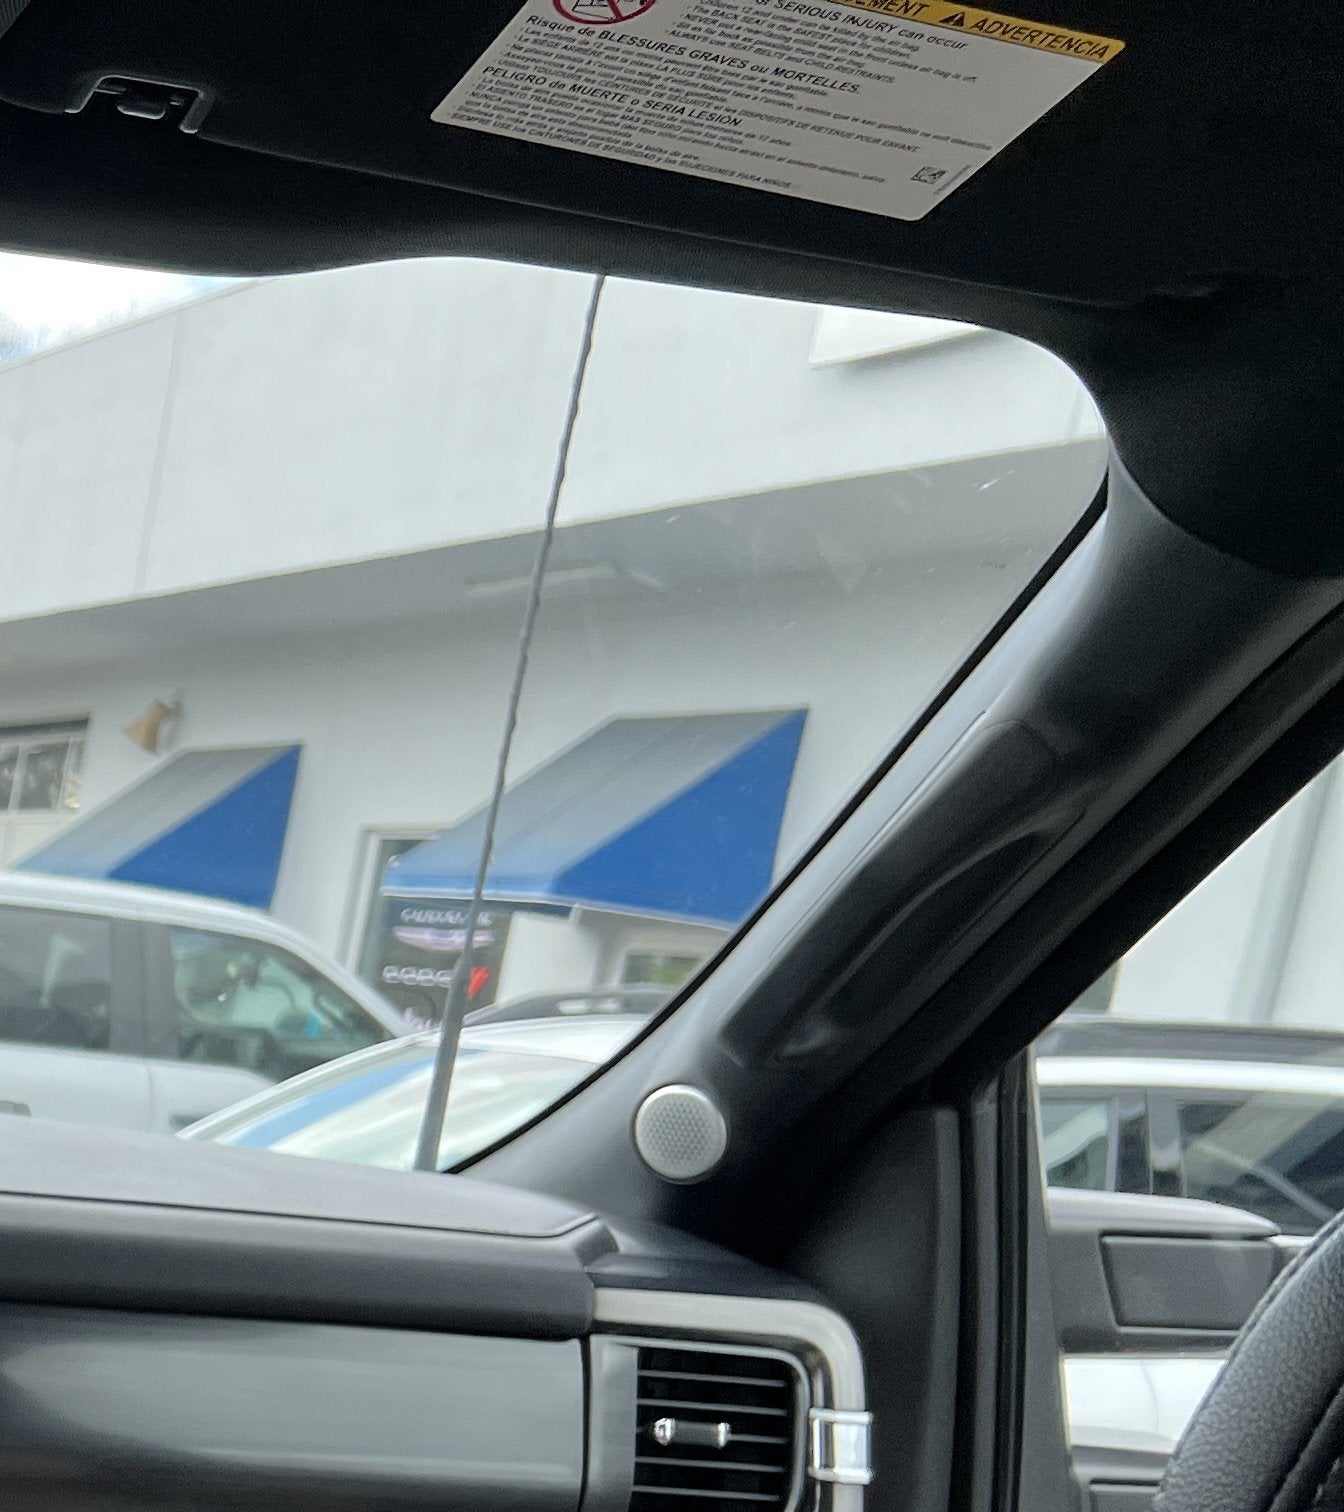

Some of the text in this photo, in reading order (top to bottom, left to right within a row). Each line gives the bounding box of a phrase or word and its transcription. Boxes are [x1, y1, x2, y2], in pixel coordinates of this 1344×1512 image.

[772, 0, 842, 21] SERIOUS
[842, 14, 898, 34] INJURY
[899, 27, 924, 41] can
[969, 18, 1111, 60] ADVERTENCIA
[526, 15, 575, 32] Risque
[577, 27, 596, 37] de
[598, 30, 687, 56] BLESSURES
[689, 49, 749, 69] GRAVES
[750, 64, 770, 74] ou
[482, 66, 547, 85] PELIGRO
[548, 80, 566, 89] de
[569, 83, 628, 103] MUERTE
[643, 100, 686, 115] SERIA
